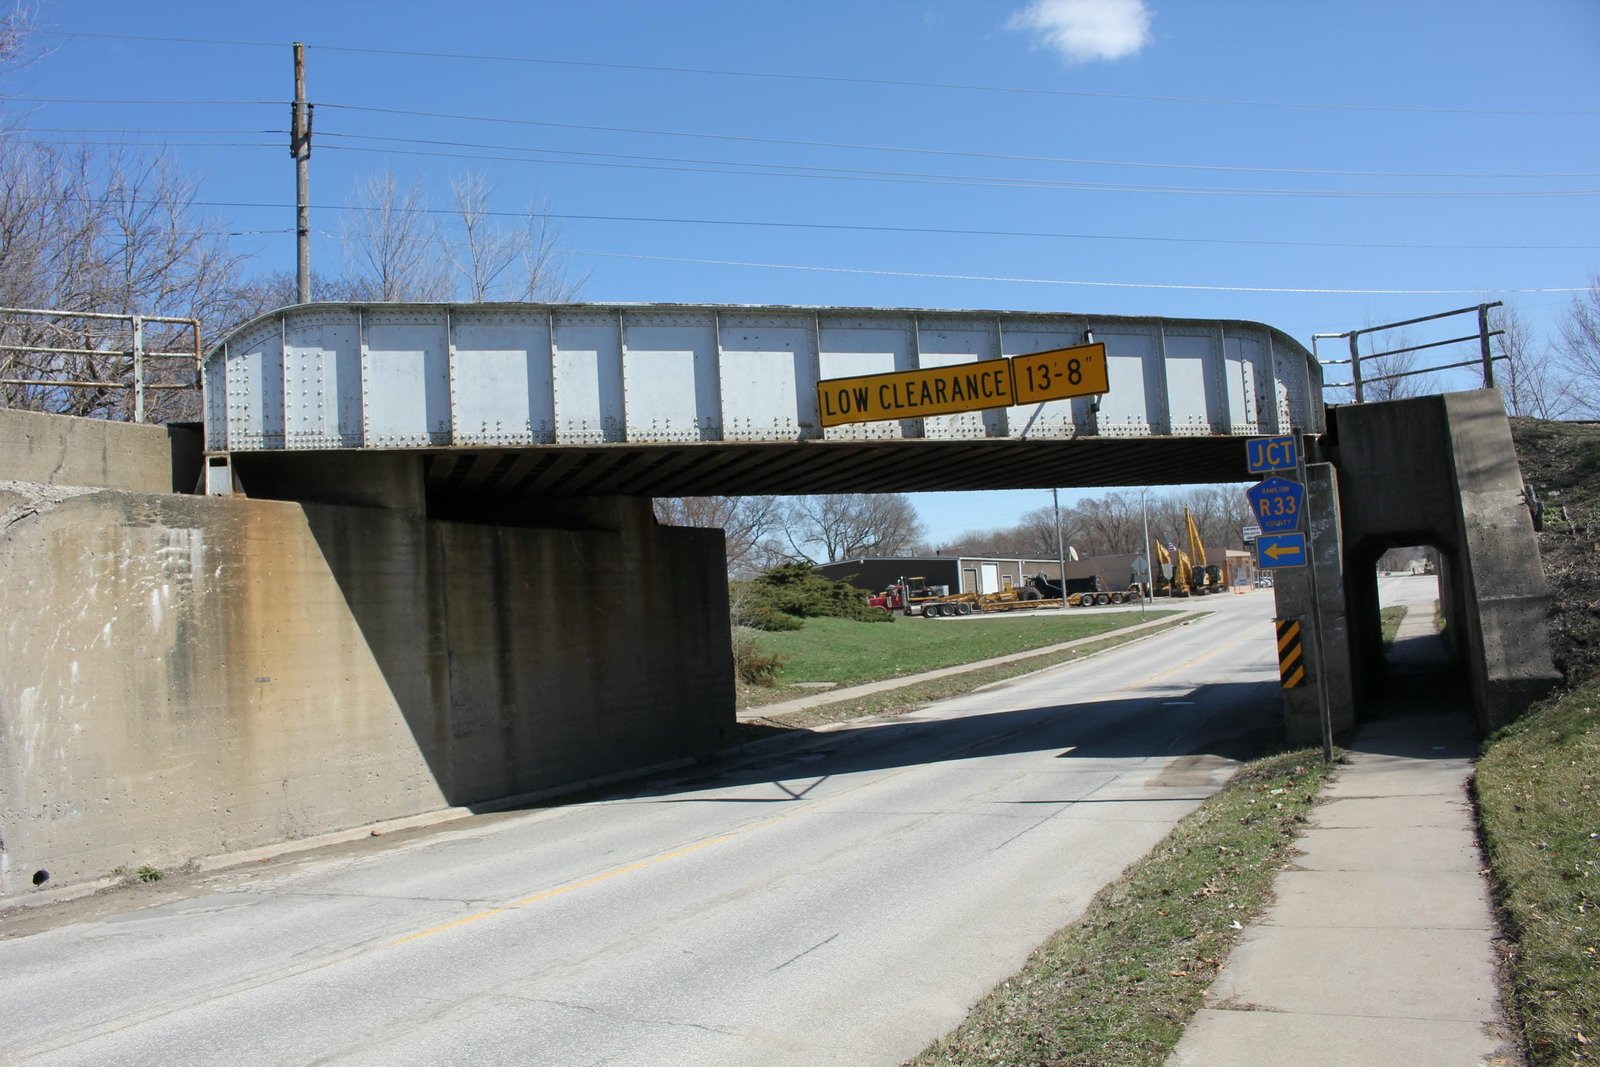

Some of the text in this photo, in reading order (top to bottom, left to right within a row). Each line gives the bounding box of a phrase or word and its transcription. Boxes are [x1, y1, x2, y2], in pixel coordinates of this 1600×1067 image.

[1026, 355, 1092, 392] 13'-8"
[824, 370, 1006, 416] LOW CLEARANCE
[1252, 441, 1292, 467] JCT
[1261, 486, 1290, 495] HAMILTON
[1265, 519, 1291, 527] COUNTY
